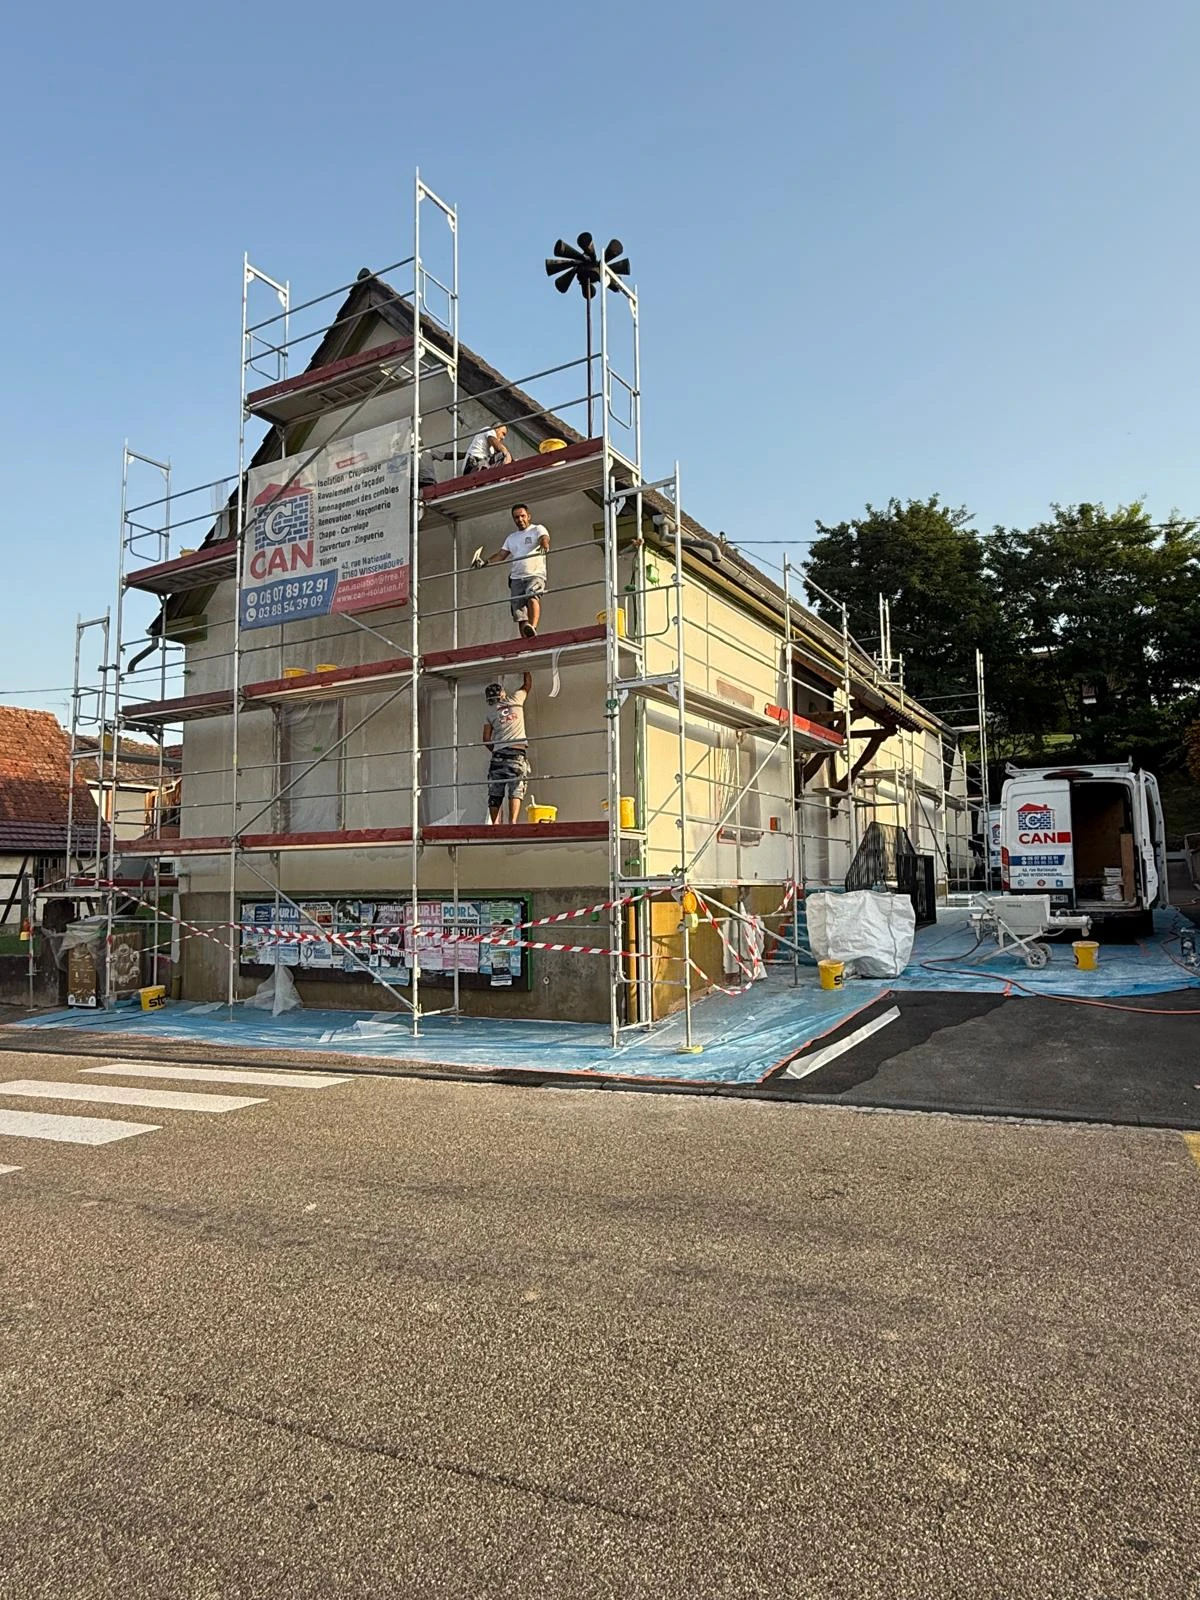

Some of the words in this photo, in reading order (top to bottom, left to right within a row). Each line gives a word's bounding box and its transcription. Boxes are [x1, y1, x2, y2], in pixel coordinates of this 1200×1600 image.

[317, 485, 353, 501] Ravalement
[318, 529, 336, 541] Chape
[340, 521, 369, 535] Carrelage
[319, 539, 351, 554] Couverture
[354, 530, 384, 545] Zinguerie
[250, 540, 314, 580] CAN
[358, 557, 404, 576] WISSEMBOURG
[362, 551, 392, 565] Nationale
[259, 589, 271, 605] 06
[272, 585, 284, 601] 07
[285, 582, 300, 598] 89
[302, 580, 314, 595] 12
[315, 577, 329, 593] 91
[258, 606, 270, 618] 03
[271, 603, 282, 616] 88
[283, 600, 295, 613] 54
[296, 597, 308, 610] 39
[310, 594, 323, 607] 09
[1018, 832, 1056, 844] CAN
